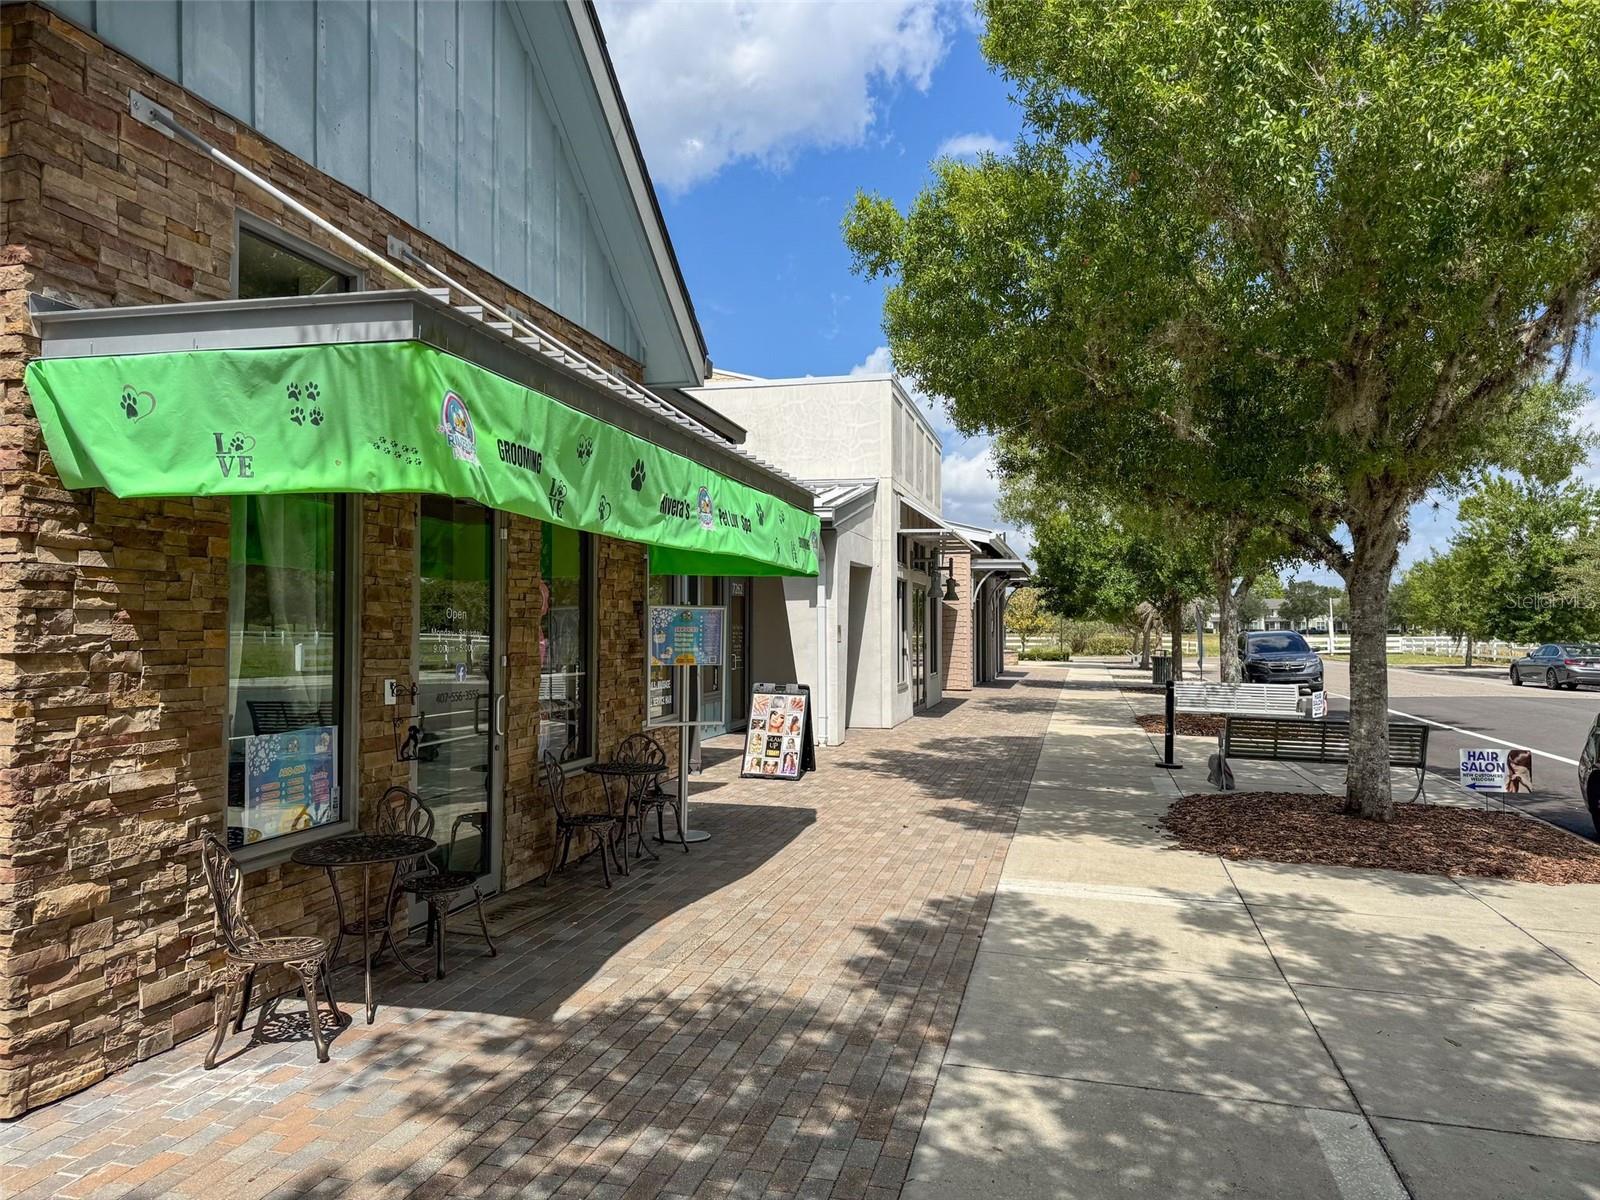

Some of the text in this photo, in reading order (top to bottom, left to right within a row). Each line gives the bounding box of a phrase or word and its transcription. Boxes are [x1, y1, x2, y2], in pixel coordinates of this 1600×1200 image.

[497, 439, 542, 475] GROOMING
[718, 508, 730, 527] Pet
[446, 607, 467, 622] Open
[1467, 751, 1499, 762] HAIR
[1461, 762, 1505, 773] SALON
